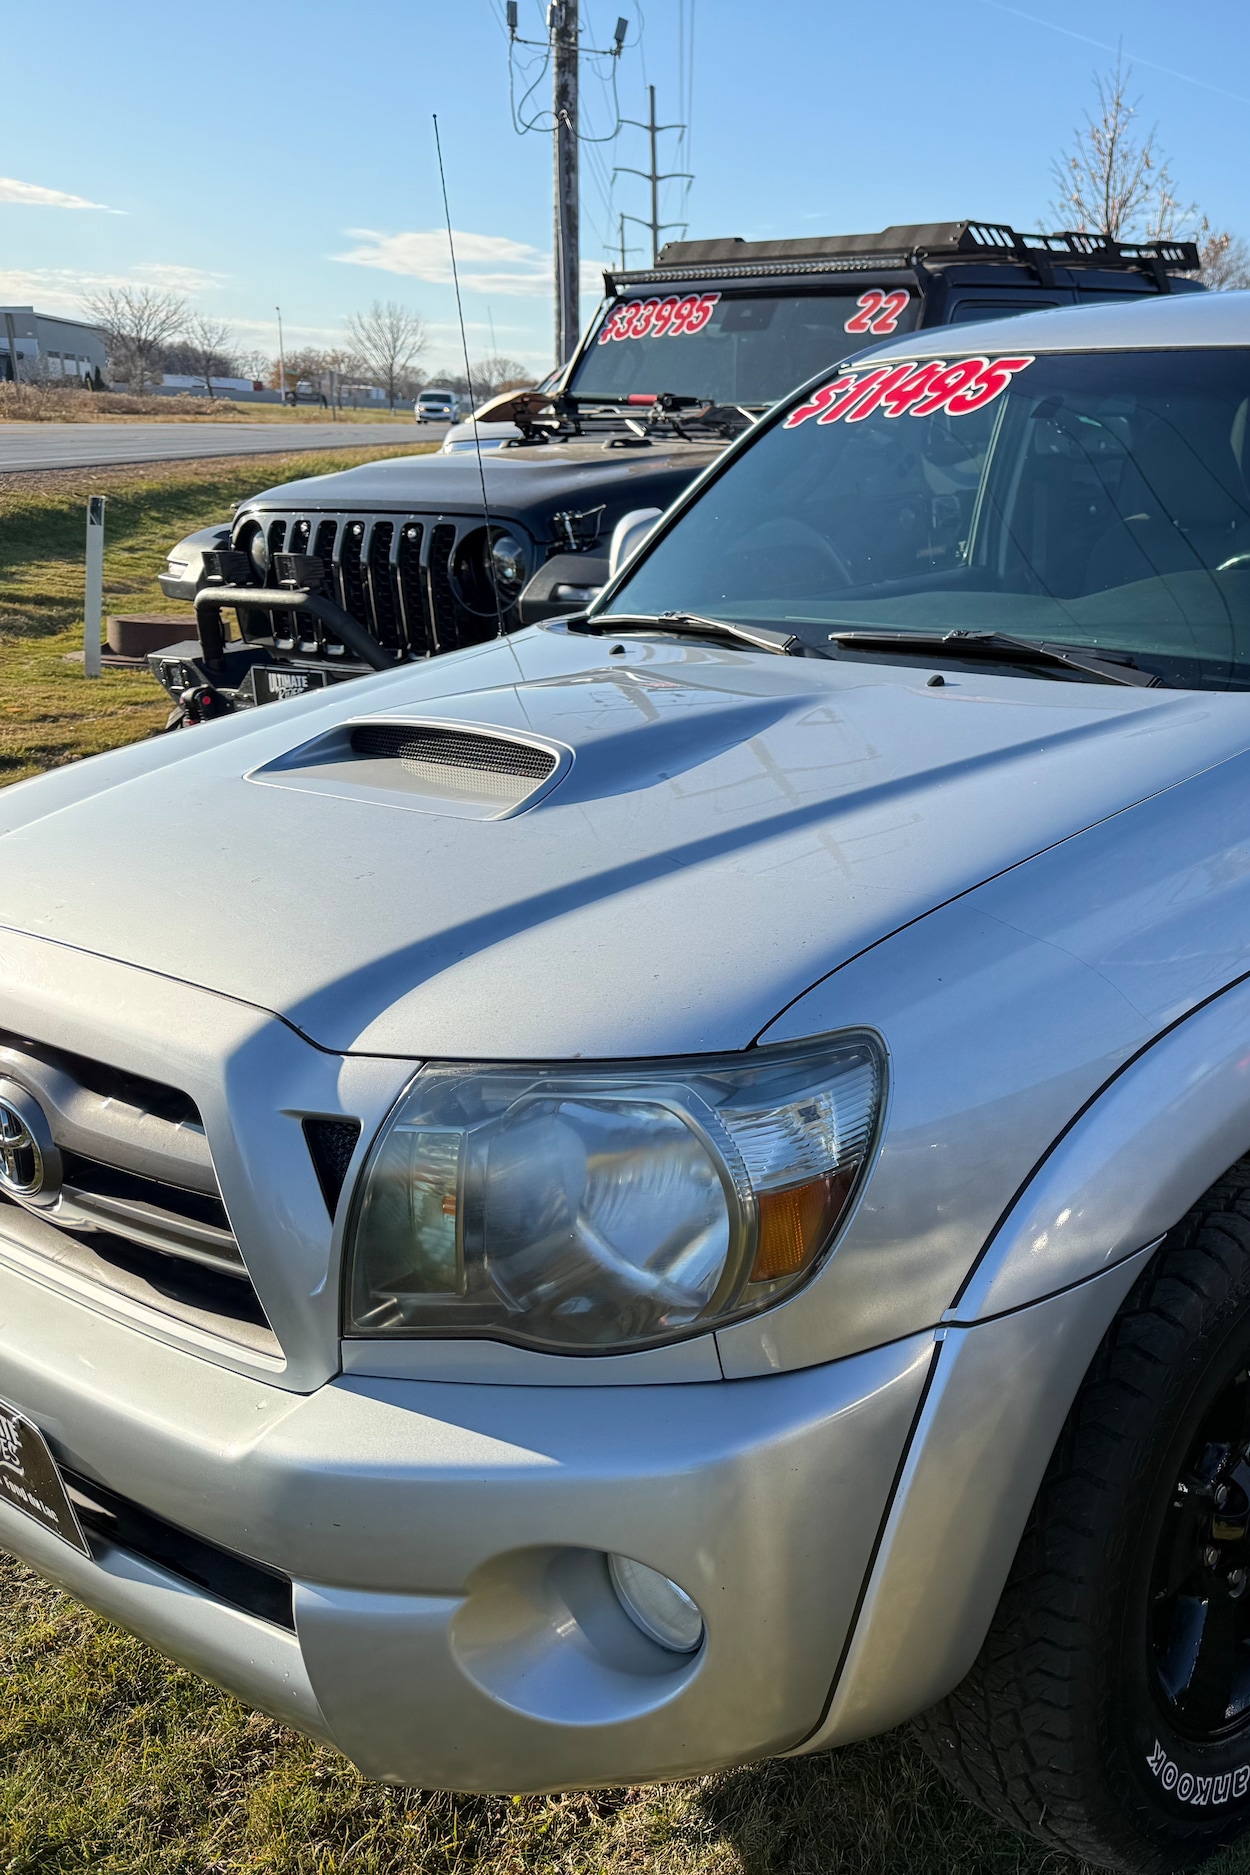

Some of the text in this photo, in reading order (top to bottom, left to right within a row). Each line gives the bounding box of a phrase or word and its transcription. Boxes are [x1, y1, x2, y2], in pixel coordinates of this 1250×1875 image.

[598, 292, 722, 345] $33995
[844, 288, 910, 335] 22
[783, 356, 1036, 429] $11495
[268, 672, 310, 693] ULTIMATE
